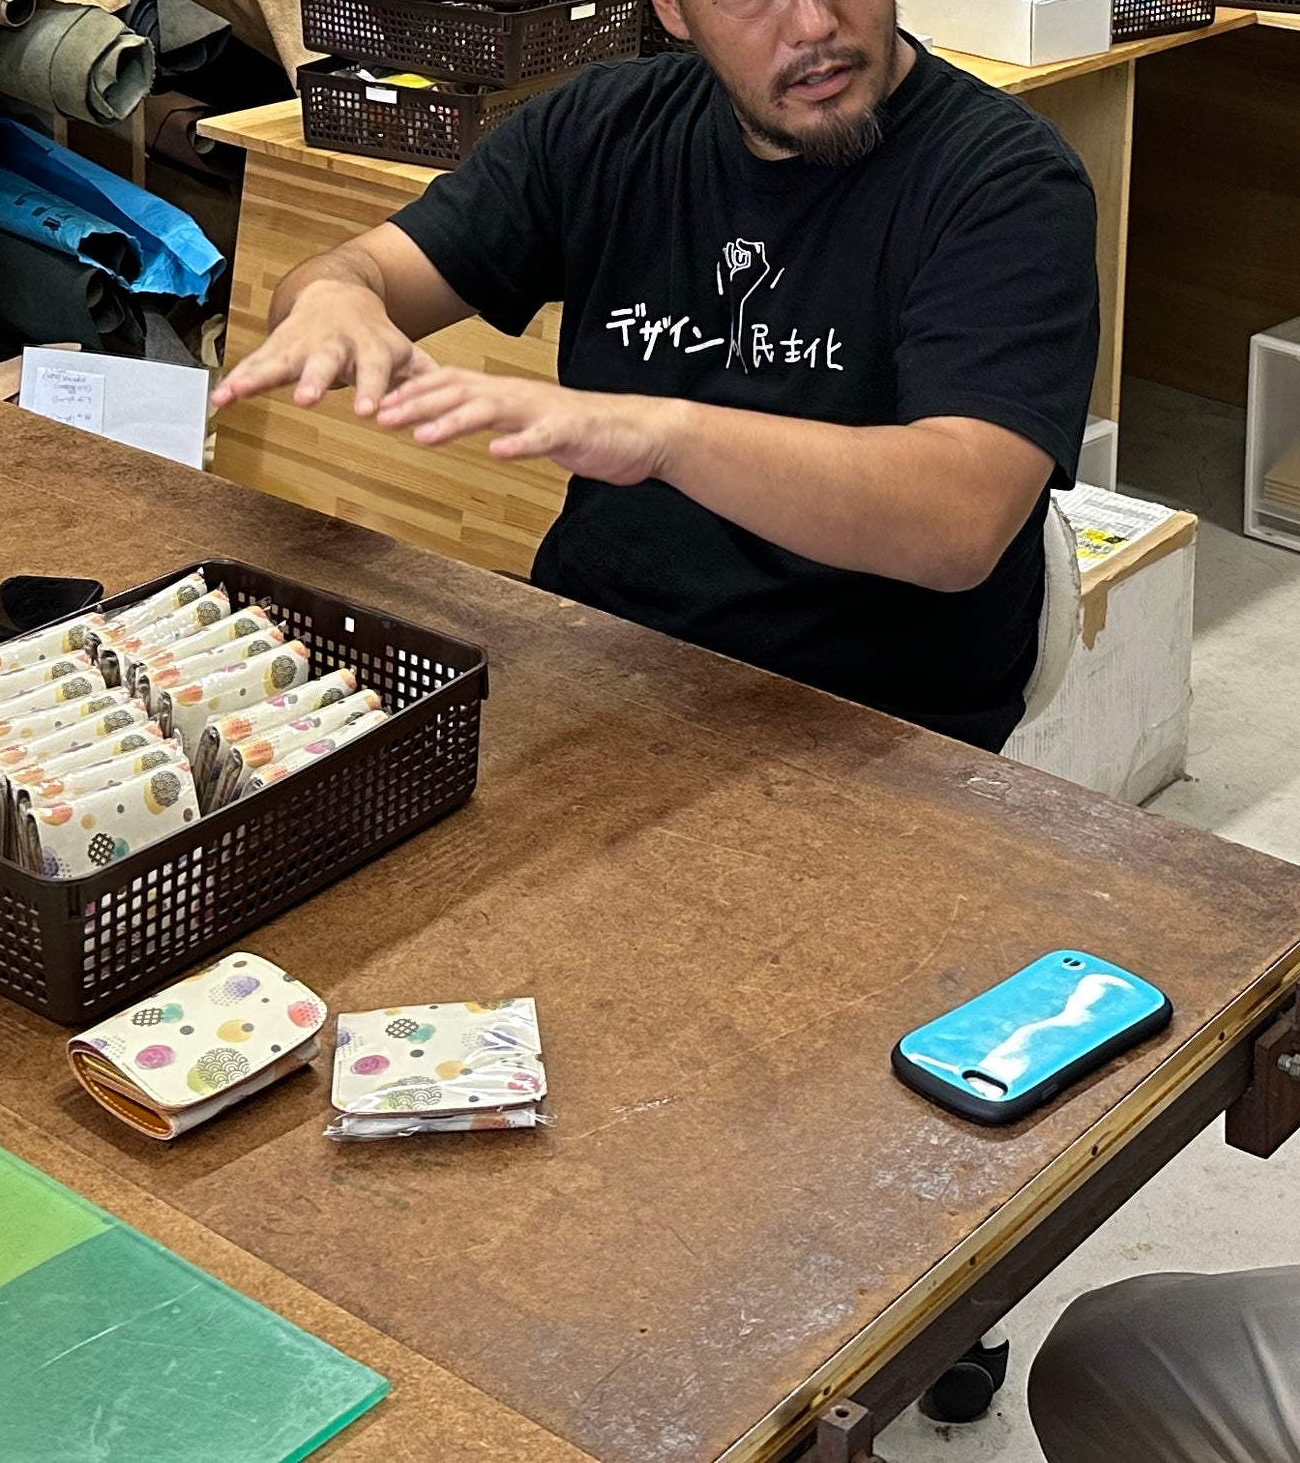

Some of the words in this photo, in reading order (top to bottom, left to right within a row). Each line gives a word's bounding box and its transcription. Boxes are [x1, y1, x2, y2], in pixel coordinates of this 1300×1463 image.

[605, 302, 725, 361] デザイン
[751, 324, 844, 371] 民主化
